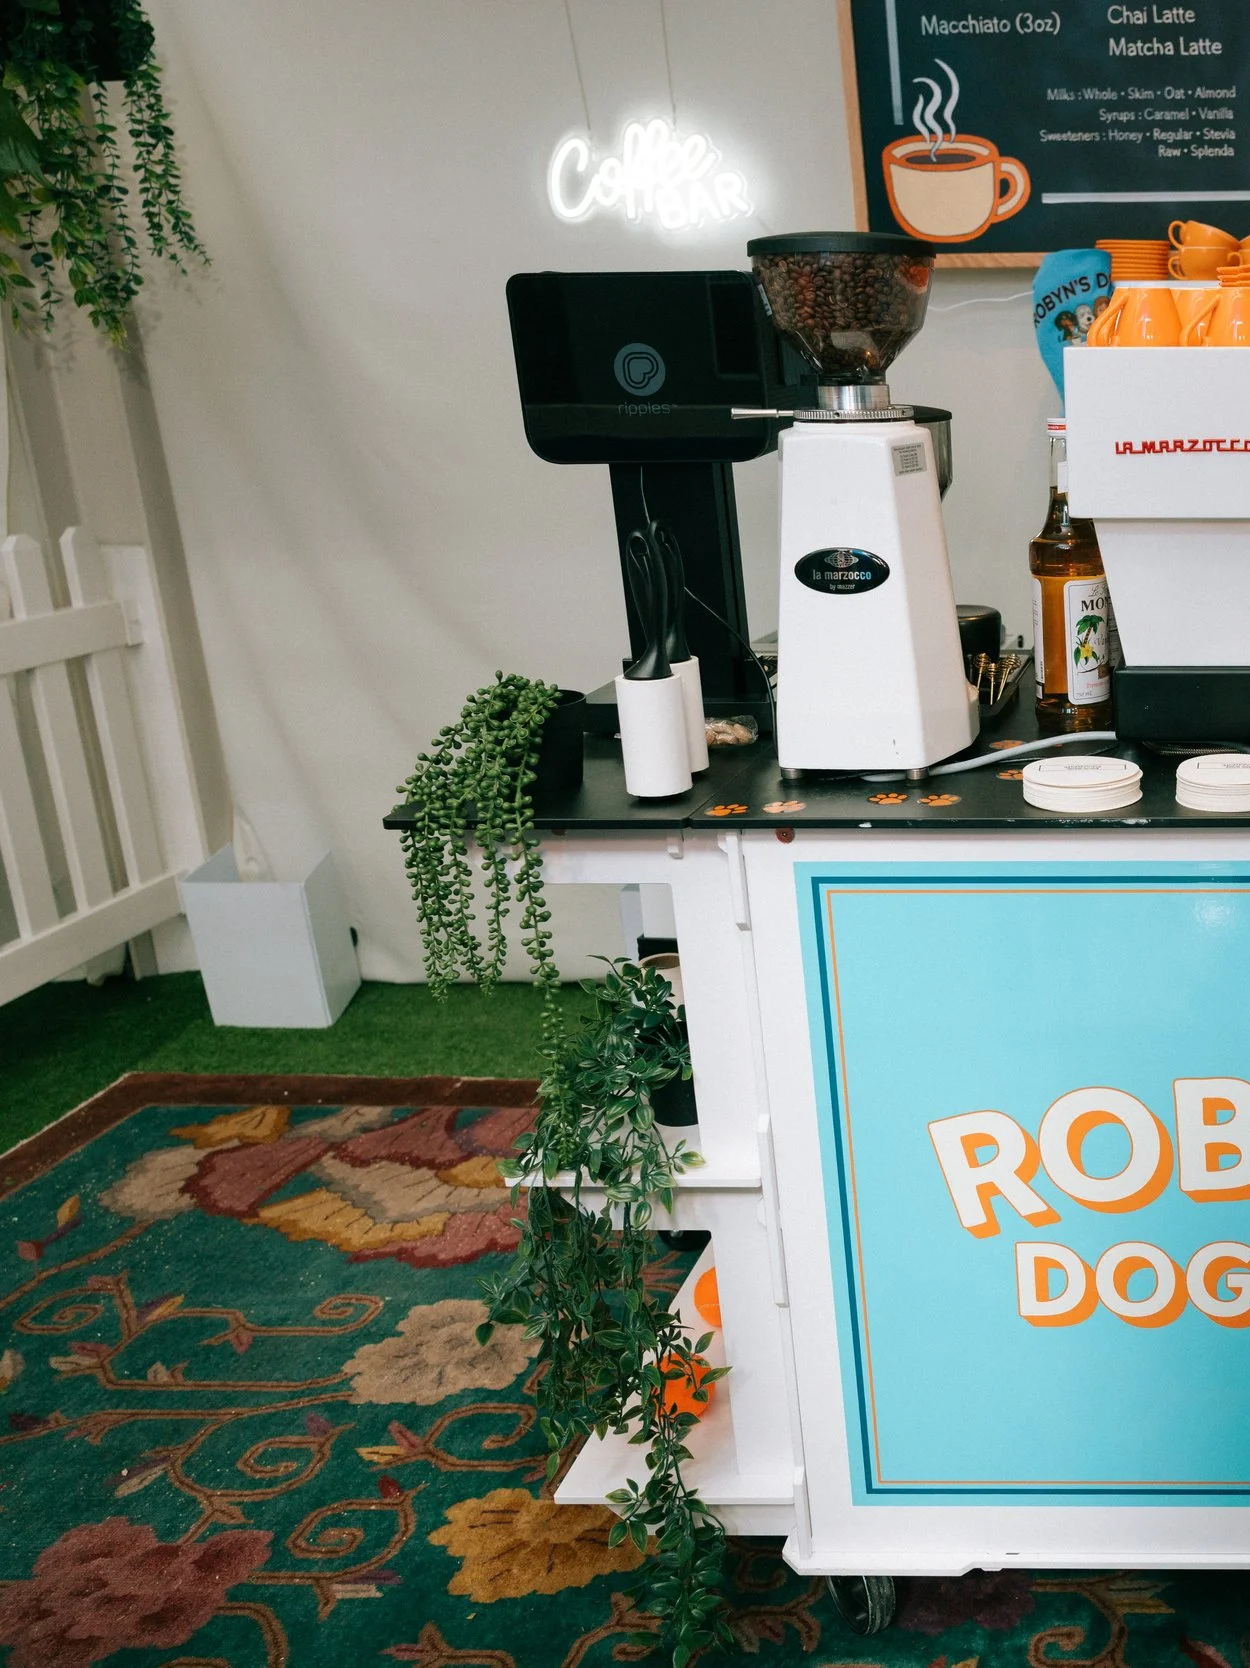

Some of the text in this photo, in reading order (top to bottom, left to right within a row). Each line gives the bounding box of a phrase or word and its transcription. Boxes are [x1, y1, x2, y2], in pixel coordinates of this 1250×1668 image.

[1107, 4, 1196, 24] Chai Latte
[921, 11, 1061, 36] Macchiato (3oz)
[1108, 36, 1222, 56] Matcha Latte
[1082, 87, 1118, 100] Whole
[1127, 87, 1154, 100] Skim
[1164, 86, 1185, 100] Oat
[1194, 85, 1236, 99] Almond
[1144, 107, 1189, 121] Caramel
[1198, 107, 1234, 120] Vanilla
[1108, 129, 1143, 144] Honey
[1153, 128, 1193, 143] Regular
[1202, 128, 1236, 141] Stevia
[1158, 144, 1235, 160] Raw Splenda
[550, 118, 719, 220] Coffee
[654, 172, 751, 230] BAR
[618, 401, 671, 416] ripples
[1115, 441, 1133, 454] LA
[812, 569, 872, 580] la marzocco
